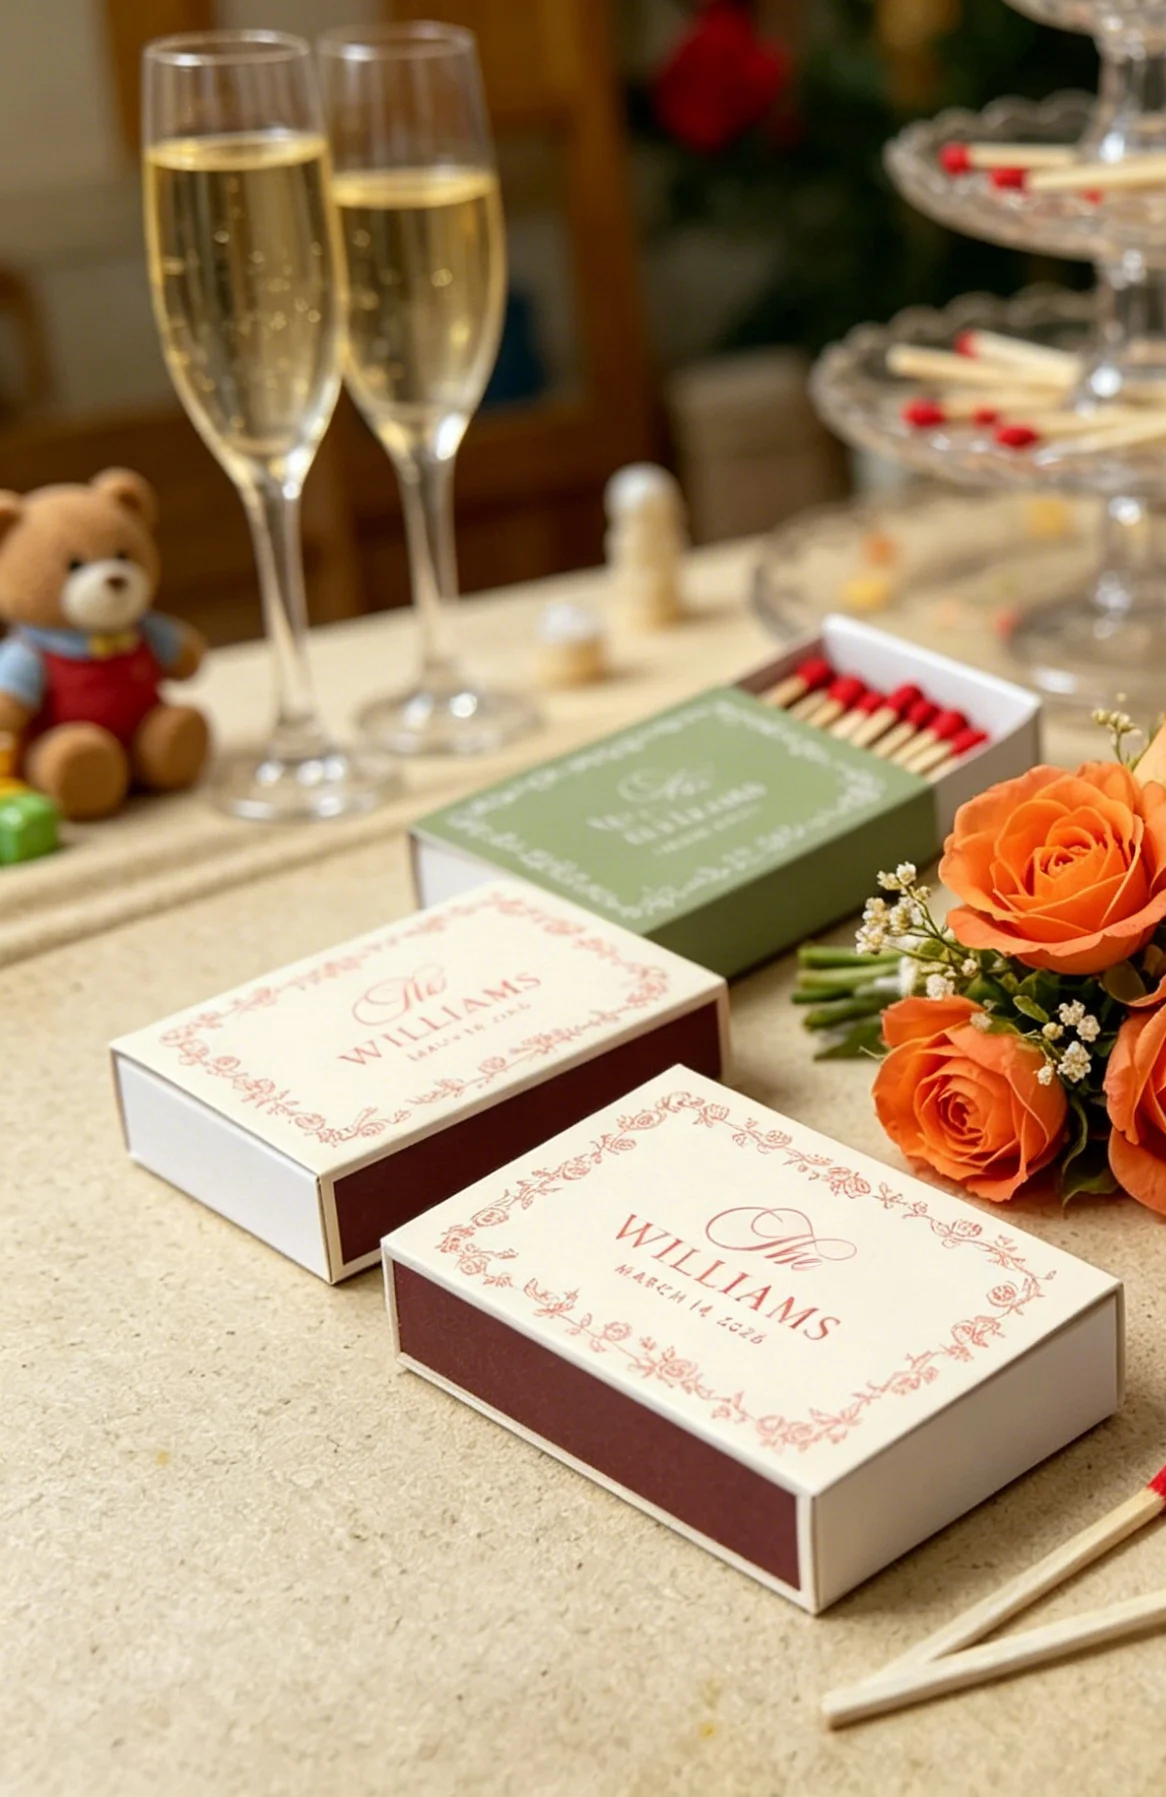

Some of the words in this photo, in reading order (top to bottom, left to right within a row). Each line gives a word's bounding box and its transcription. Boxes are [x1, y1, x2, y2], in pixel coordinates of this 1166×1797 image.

[337, 972, 541, 1065] WILLIAMS
[615, 1213, 841, 1341] WILLIAMS
[705, 1206, 857, 1271] The
[614, 1263, 687, 1305] MARCH
